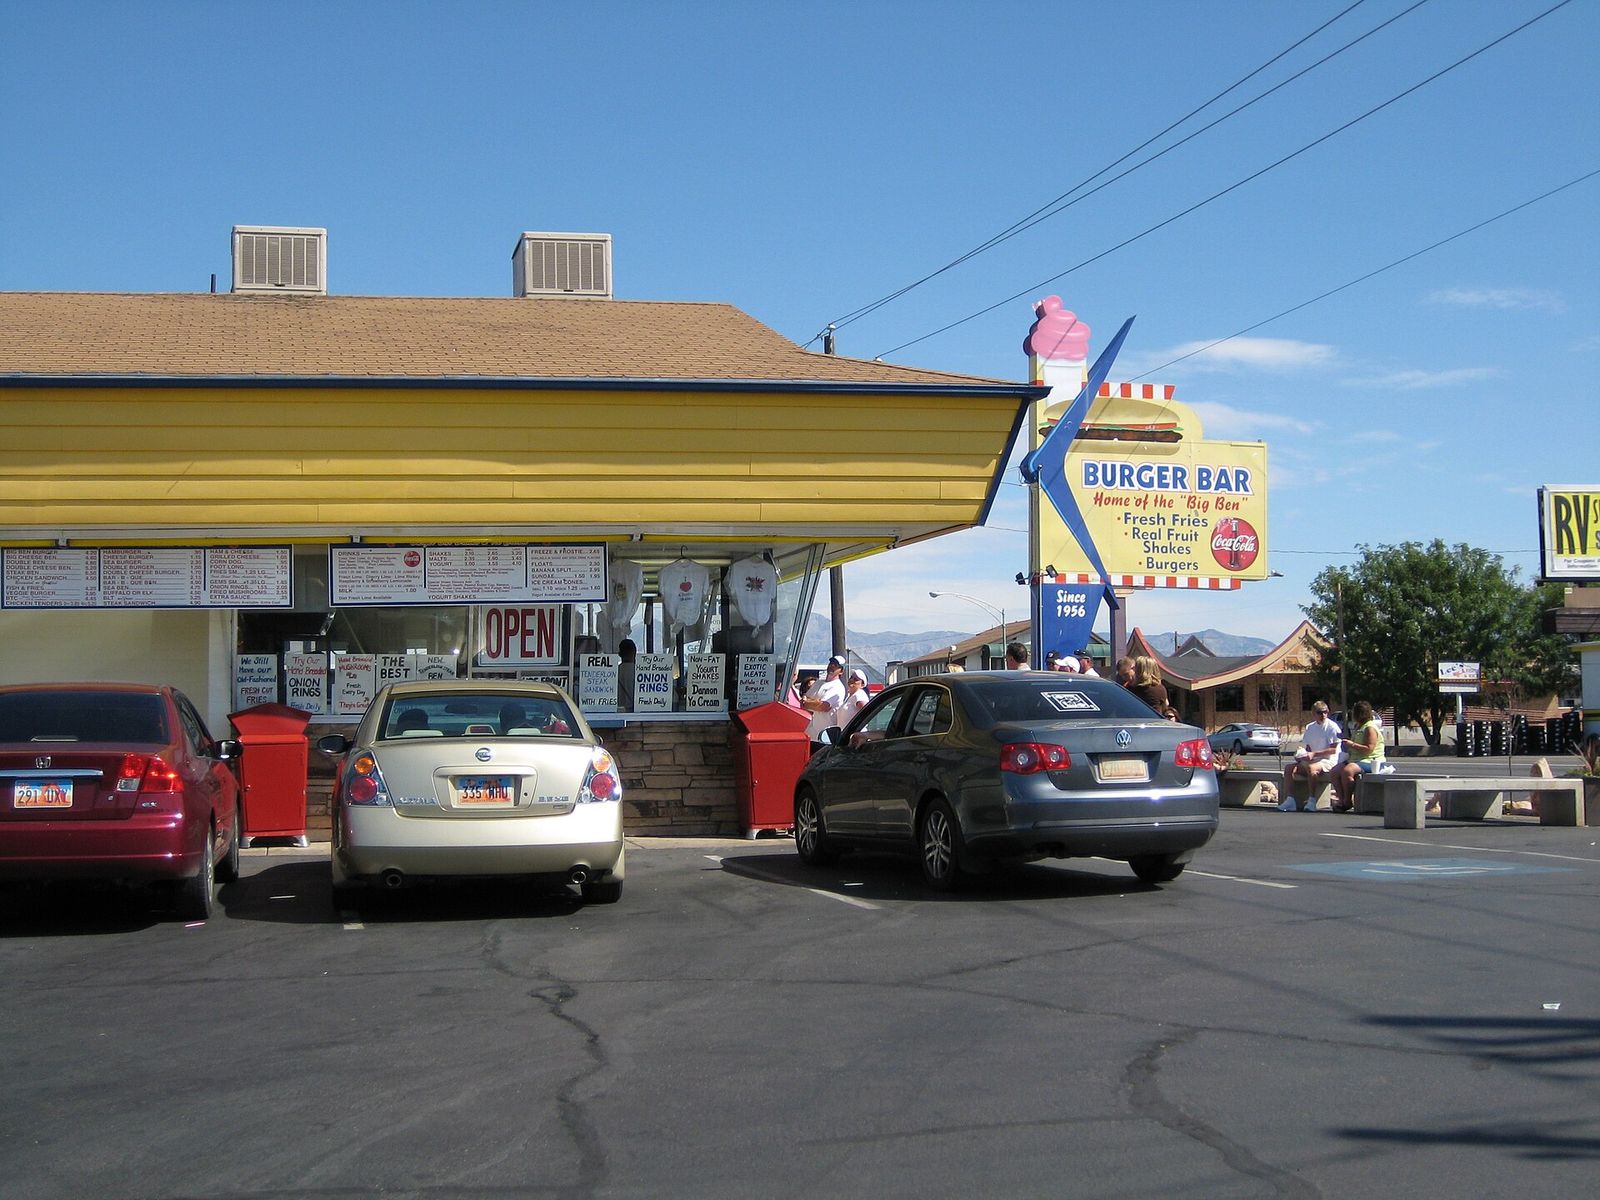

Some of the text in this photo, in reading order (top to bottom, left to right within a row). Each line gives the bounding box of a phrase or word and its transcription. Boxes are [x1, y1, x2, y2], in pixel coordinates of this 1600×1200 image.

[1083, 462, 1250, 492] BURGER BAR
[1093, 492, 1248, 513] Home of the "Big Ben"
[1124, 512, 1208, 528] Fresh Fries
[1554, 494, 1590, 554] RV
[1132, 528, 1199, 542] Real Fruit
[1143, 541, 1191, 554] Shakes
[1212, 533, 1256, 552] Coca-Cola
[1146, 557, 1199, 572] Burgers
[1056, 590, 1086, 603] Since
[1056, 604, 1086, 618] 1956
[486, 608, 555, 658] OPEN
[292, 657, 305, 666] Try
[382, 656, 405, 667] THE
[588, 656, 613, 667] REAL
[642, 656, 652, 664] Try
[380, 668, 410, 679] BEST
[637, 673, 668, 683] ONION
[289, 678, 320, 687] ONION
[639, 683, 668, 692] RINGS
[292, 688, 321, 697] RINGS
[692, 685, 718, 695] Dannon
[246, 696, 267, 704] FRIES
[18, 790, 38, 805] 291
[463, 786, 481, 798] 335
